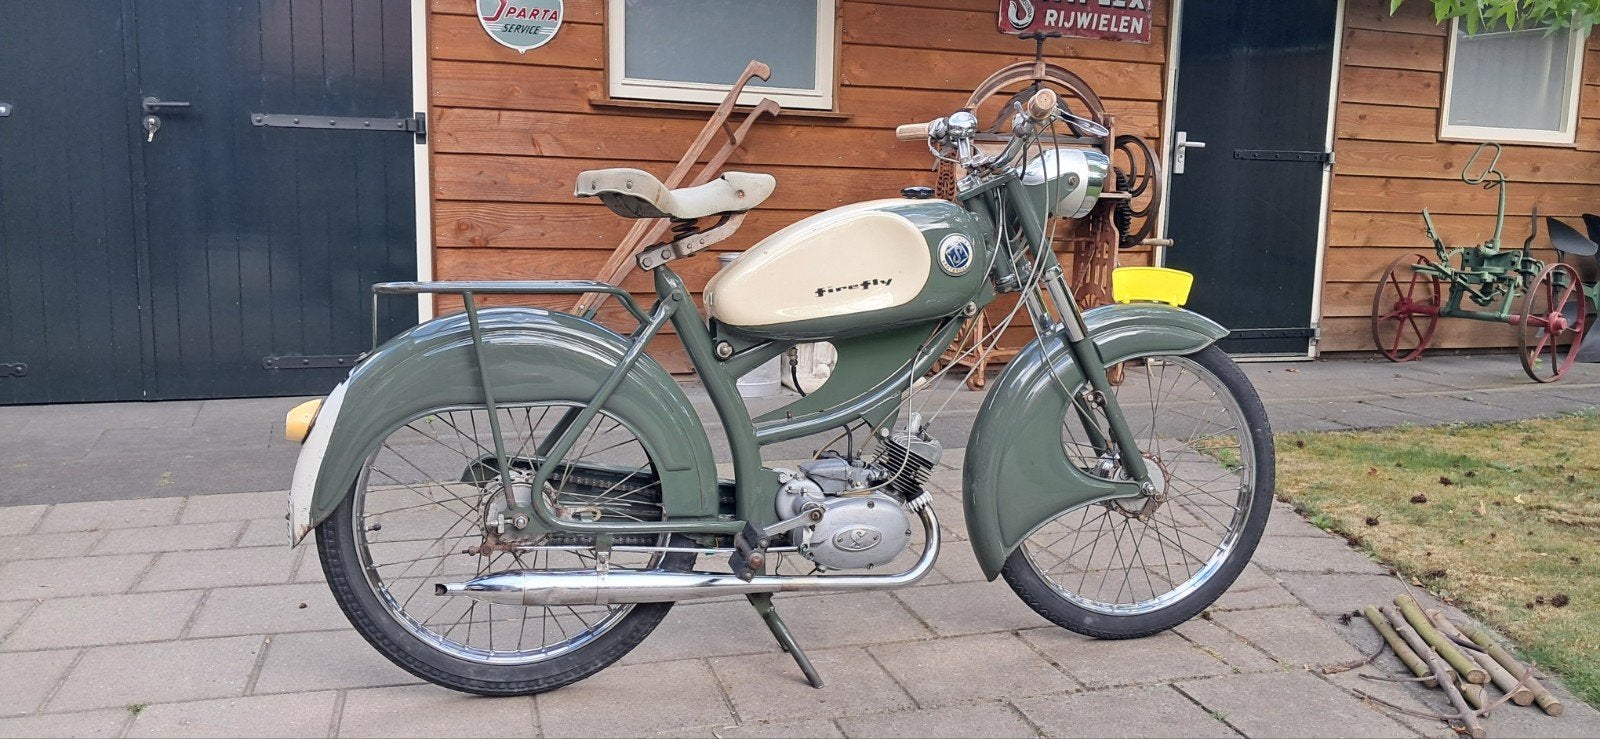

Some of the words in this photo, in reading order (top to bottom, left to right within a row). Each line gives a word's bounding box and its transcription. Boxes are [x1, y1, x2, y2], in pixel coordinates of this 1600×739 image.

[501, 23, 541, 35] SERVICE
[1044, 9, 1143, 34] RIJWIELEN
[815, 278, 893, 297] firefly
